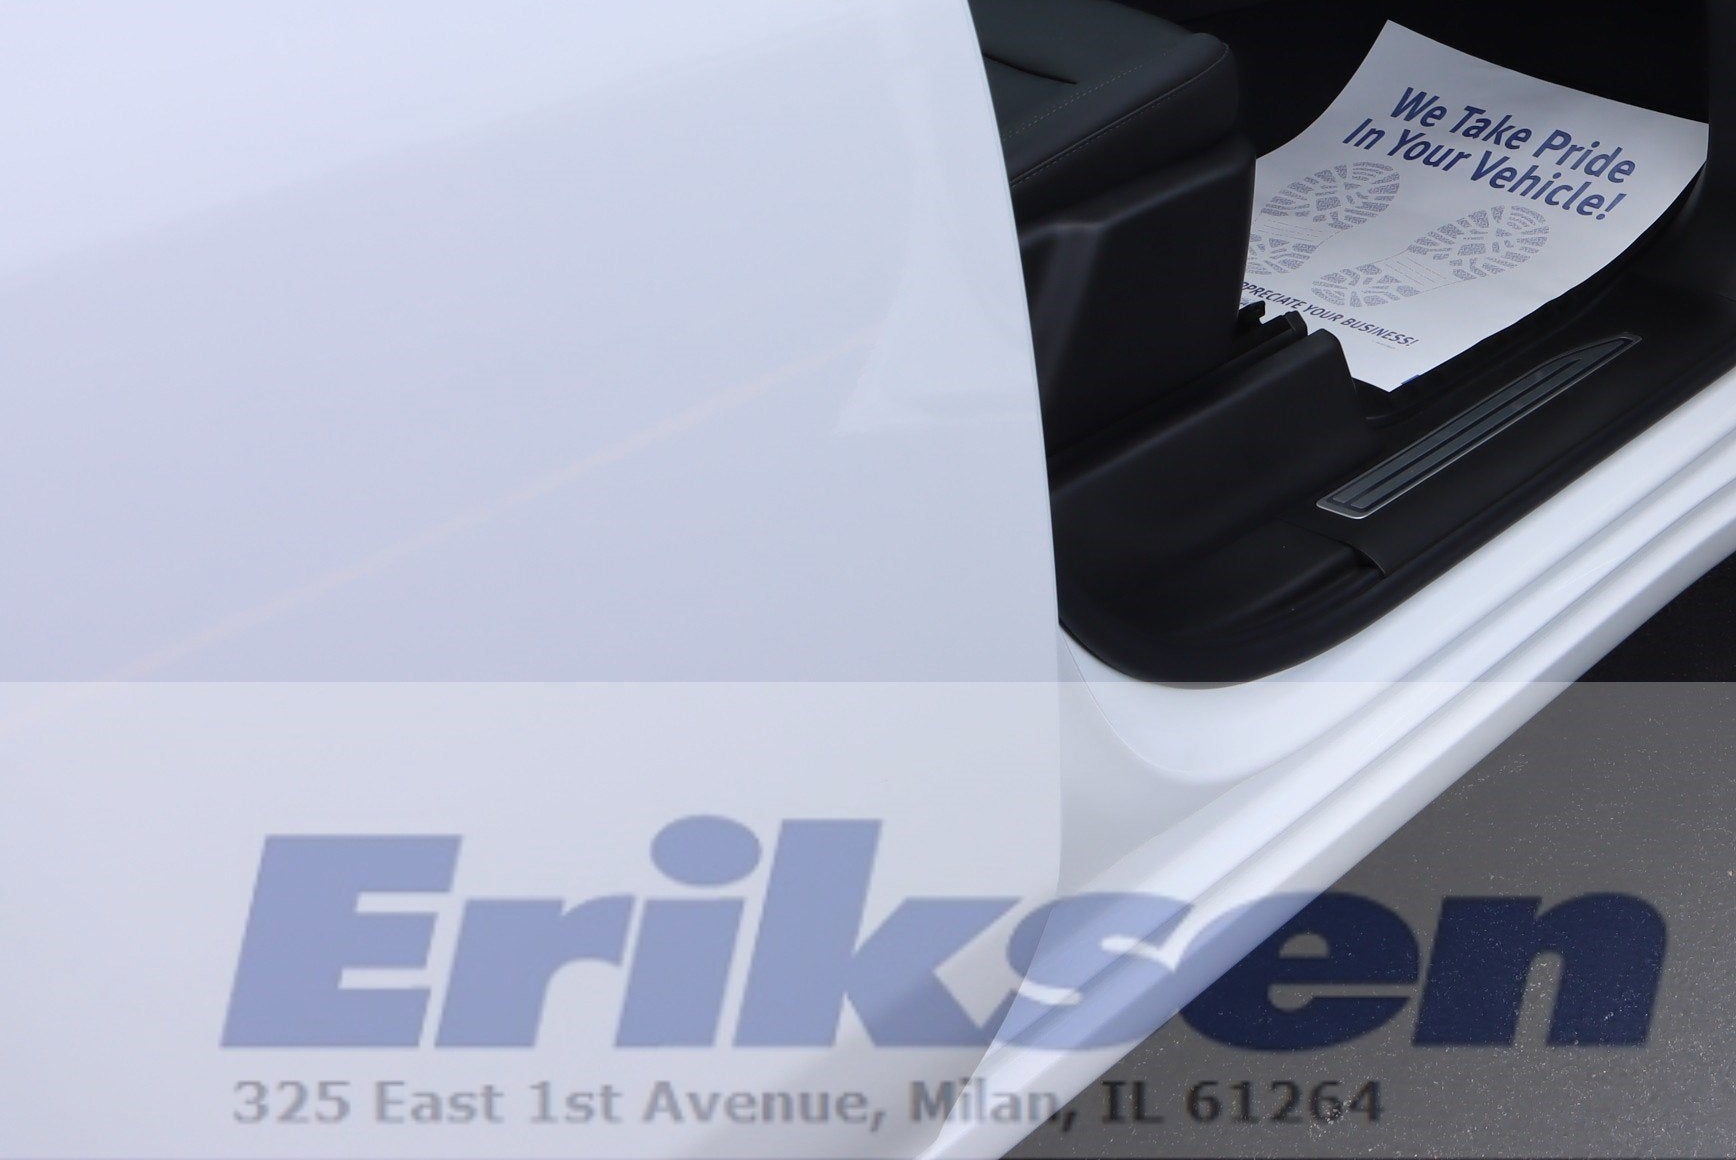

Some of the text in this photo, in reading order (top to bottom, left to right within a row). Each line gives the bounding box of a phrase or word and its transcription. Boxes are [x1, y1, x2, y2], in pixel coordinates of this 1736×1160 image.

[1342, 118, 1627, 220] In Your Vehicle!
[1390, 86, 1636, 184] We Take Pride
[1303, 304, 1345, 323] YOUR
[1341, 318, 1420, 347] BUSINESS!
